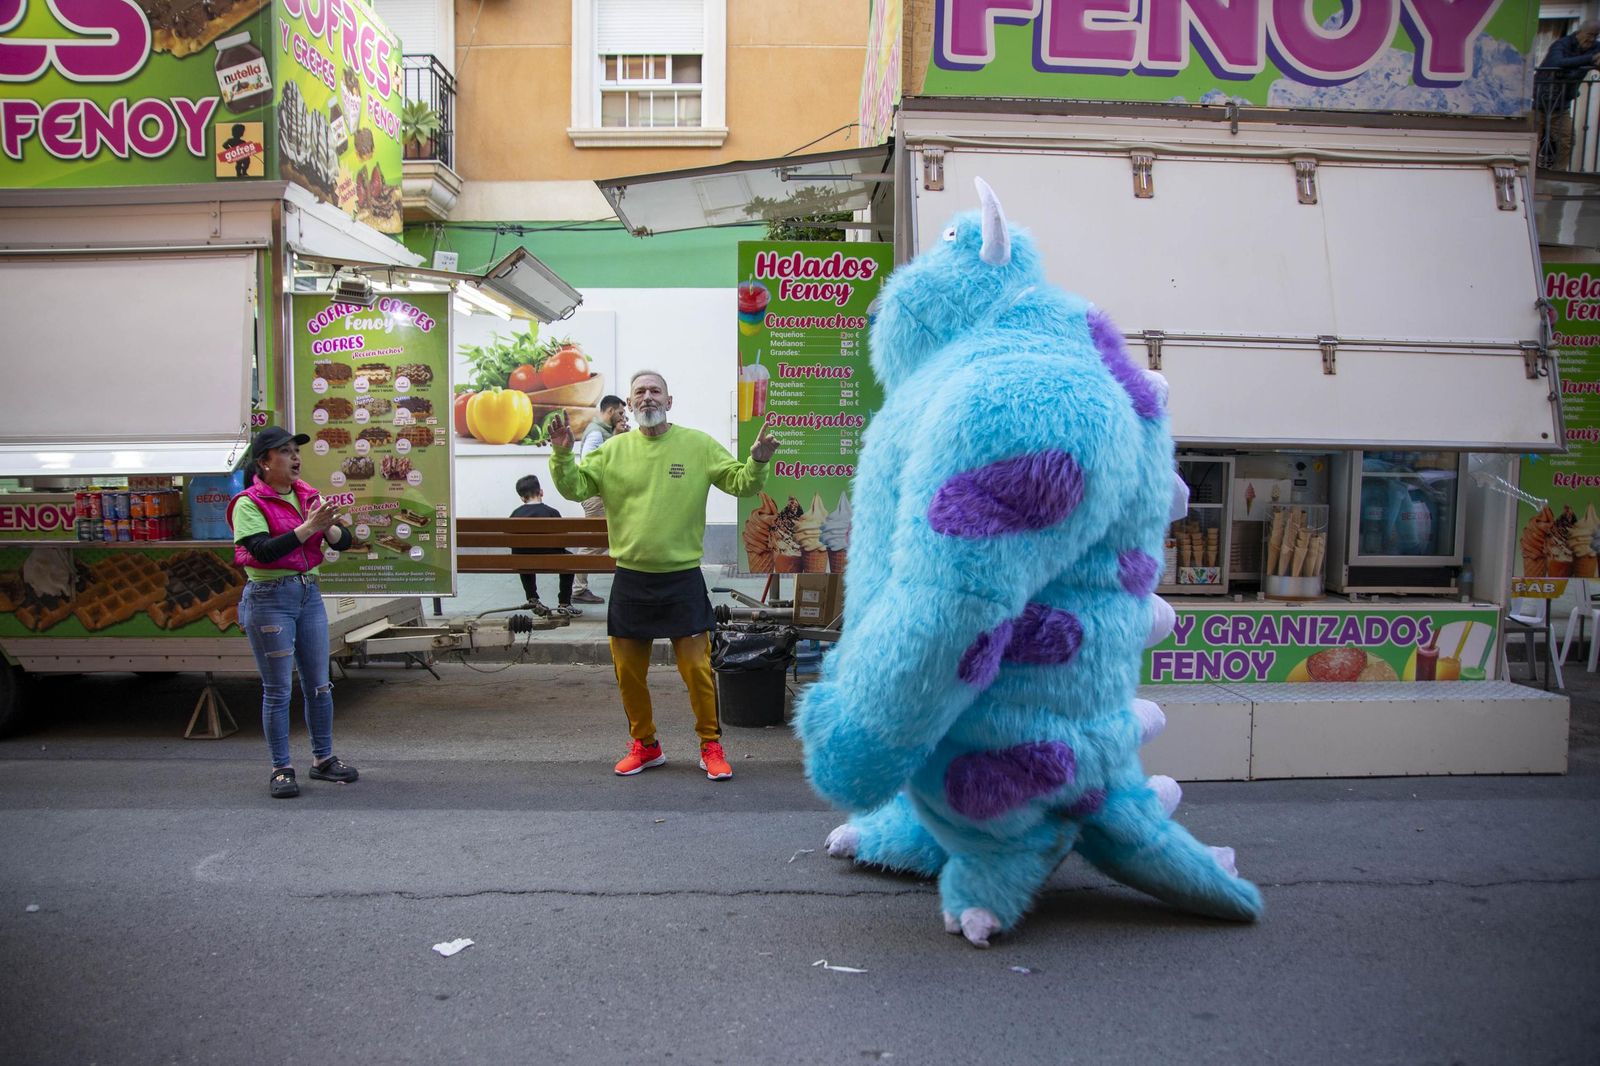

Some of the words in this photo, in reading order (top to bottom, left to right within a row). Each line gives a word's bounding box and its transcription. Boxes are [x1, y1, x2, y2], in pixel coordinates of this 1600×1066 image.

[280, 17, 290, 55] Y
[293, 32, 336, 91] CREPES
[284, 0, 391, 100] OFRES
[935, 0, 1492, 88] FENOY
[223, 64, 262, 85] nutella
[2, 97, 220, 160] FENOY
[367, 91, 401, 144] FENOY
[224, 142, 256, 163] gofres
[755, 251, 878, 280] Helados
[779, 278, 854, 306] Fenoy
[307, 302, 363, 334] GOFRES
[344, 314, 396, 334] Fenoy
[764, 312, 867, 329] Cucuruchos
[312, 335, 365, 356] GOFRES
[778, 362, 855, 379] Tarrinas
[765, 411, 865, 430] Granizados
[779, 439, 806, 447] dianos:
[774, 461, 855, 480] Refrescos
[1173, 614, 1195, 646] Y
[1203, 614, 1434, 647] GRANIZADOS
[1151, 650, 1276, 681] FENOY
